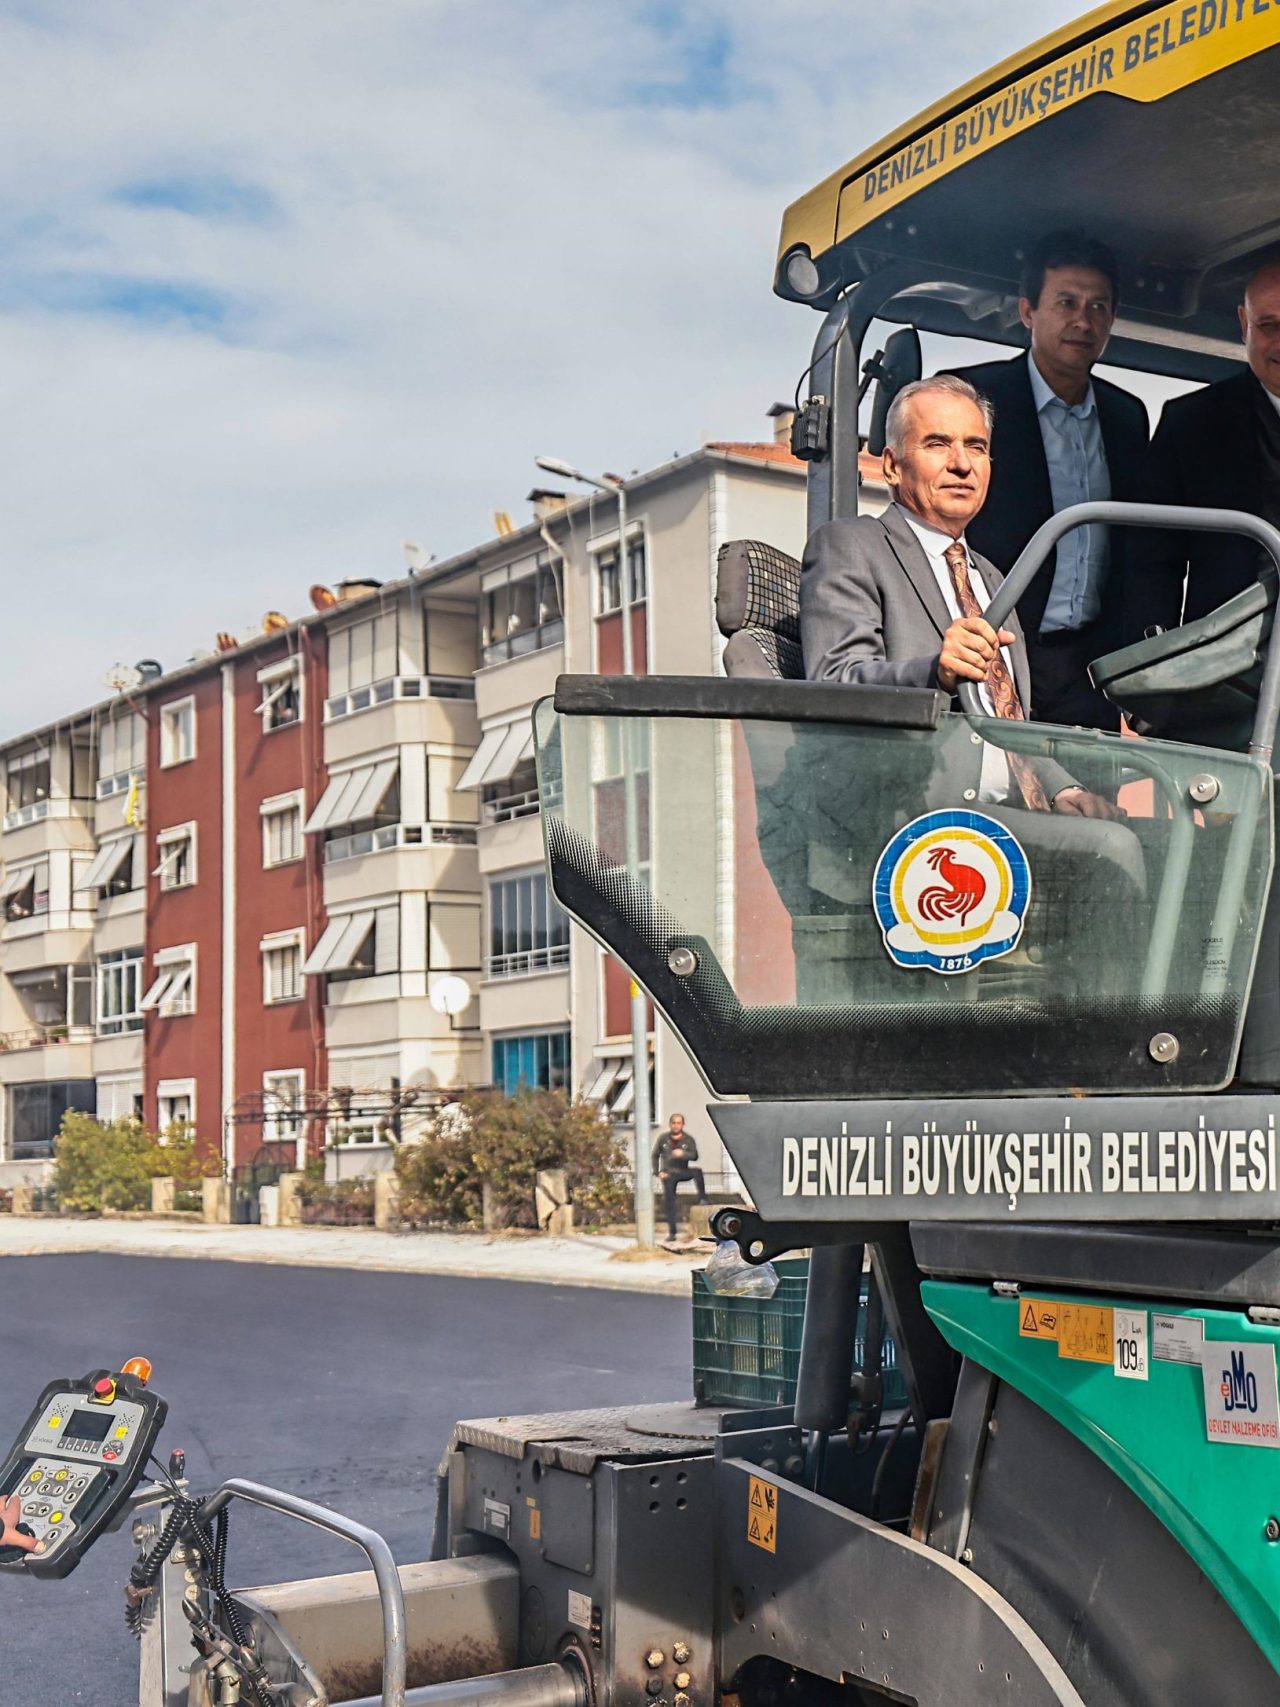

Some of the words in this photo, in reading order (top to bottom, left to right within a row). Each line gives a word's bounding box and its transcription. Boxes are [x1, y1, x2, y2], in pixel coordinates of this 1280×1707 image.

[863, 125, 947, 202] DENİZLİ
[952, 47, 1115, 155] BÜYÜKŞEHİR
[940, 957, 973, 970] 1876
[782, 1121, 893, 1197] DENİZLİ
[902, 1116, 1094, 1211] BÜYÜKŞEHİR
[1101, 1114, 1276, 1192] BELEDİYESİ
[1116, 1338, 1138, 1371] 109
[1208, 1418, 1231, 1433] DEVLET
